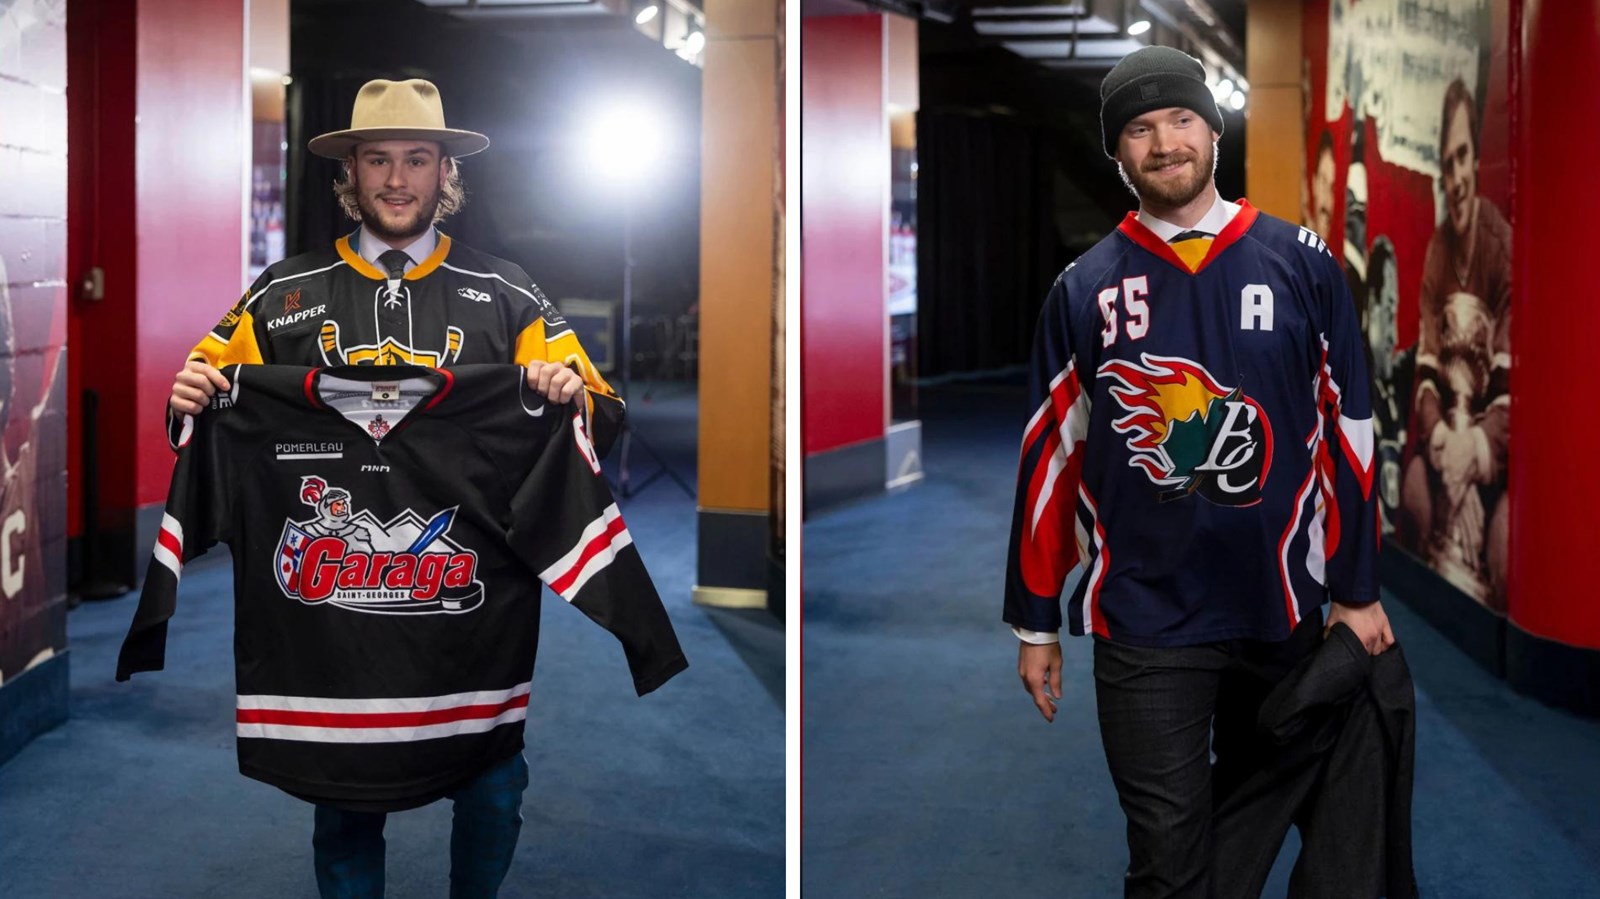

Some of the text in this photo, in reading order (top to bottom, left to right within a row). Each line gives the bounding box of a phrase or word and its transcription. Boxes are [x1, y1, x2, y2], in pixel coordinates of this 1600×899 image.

[267, 304, 326, 331] KNAPPER
[1098, 275, 1149, 348] 55
[1240, 284, 1274, 331] A
[275, 442, 344, 453] POMERLEAU
[1, 509, 26, 600] C
[299, 536, 476, 602] Garaga
